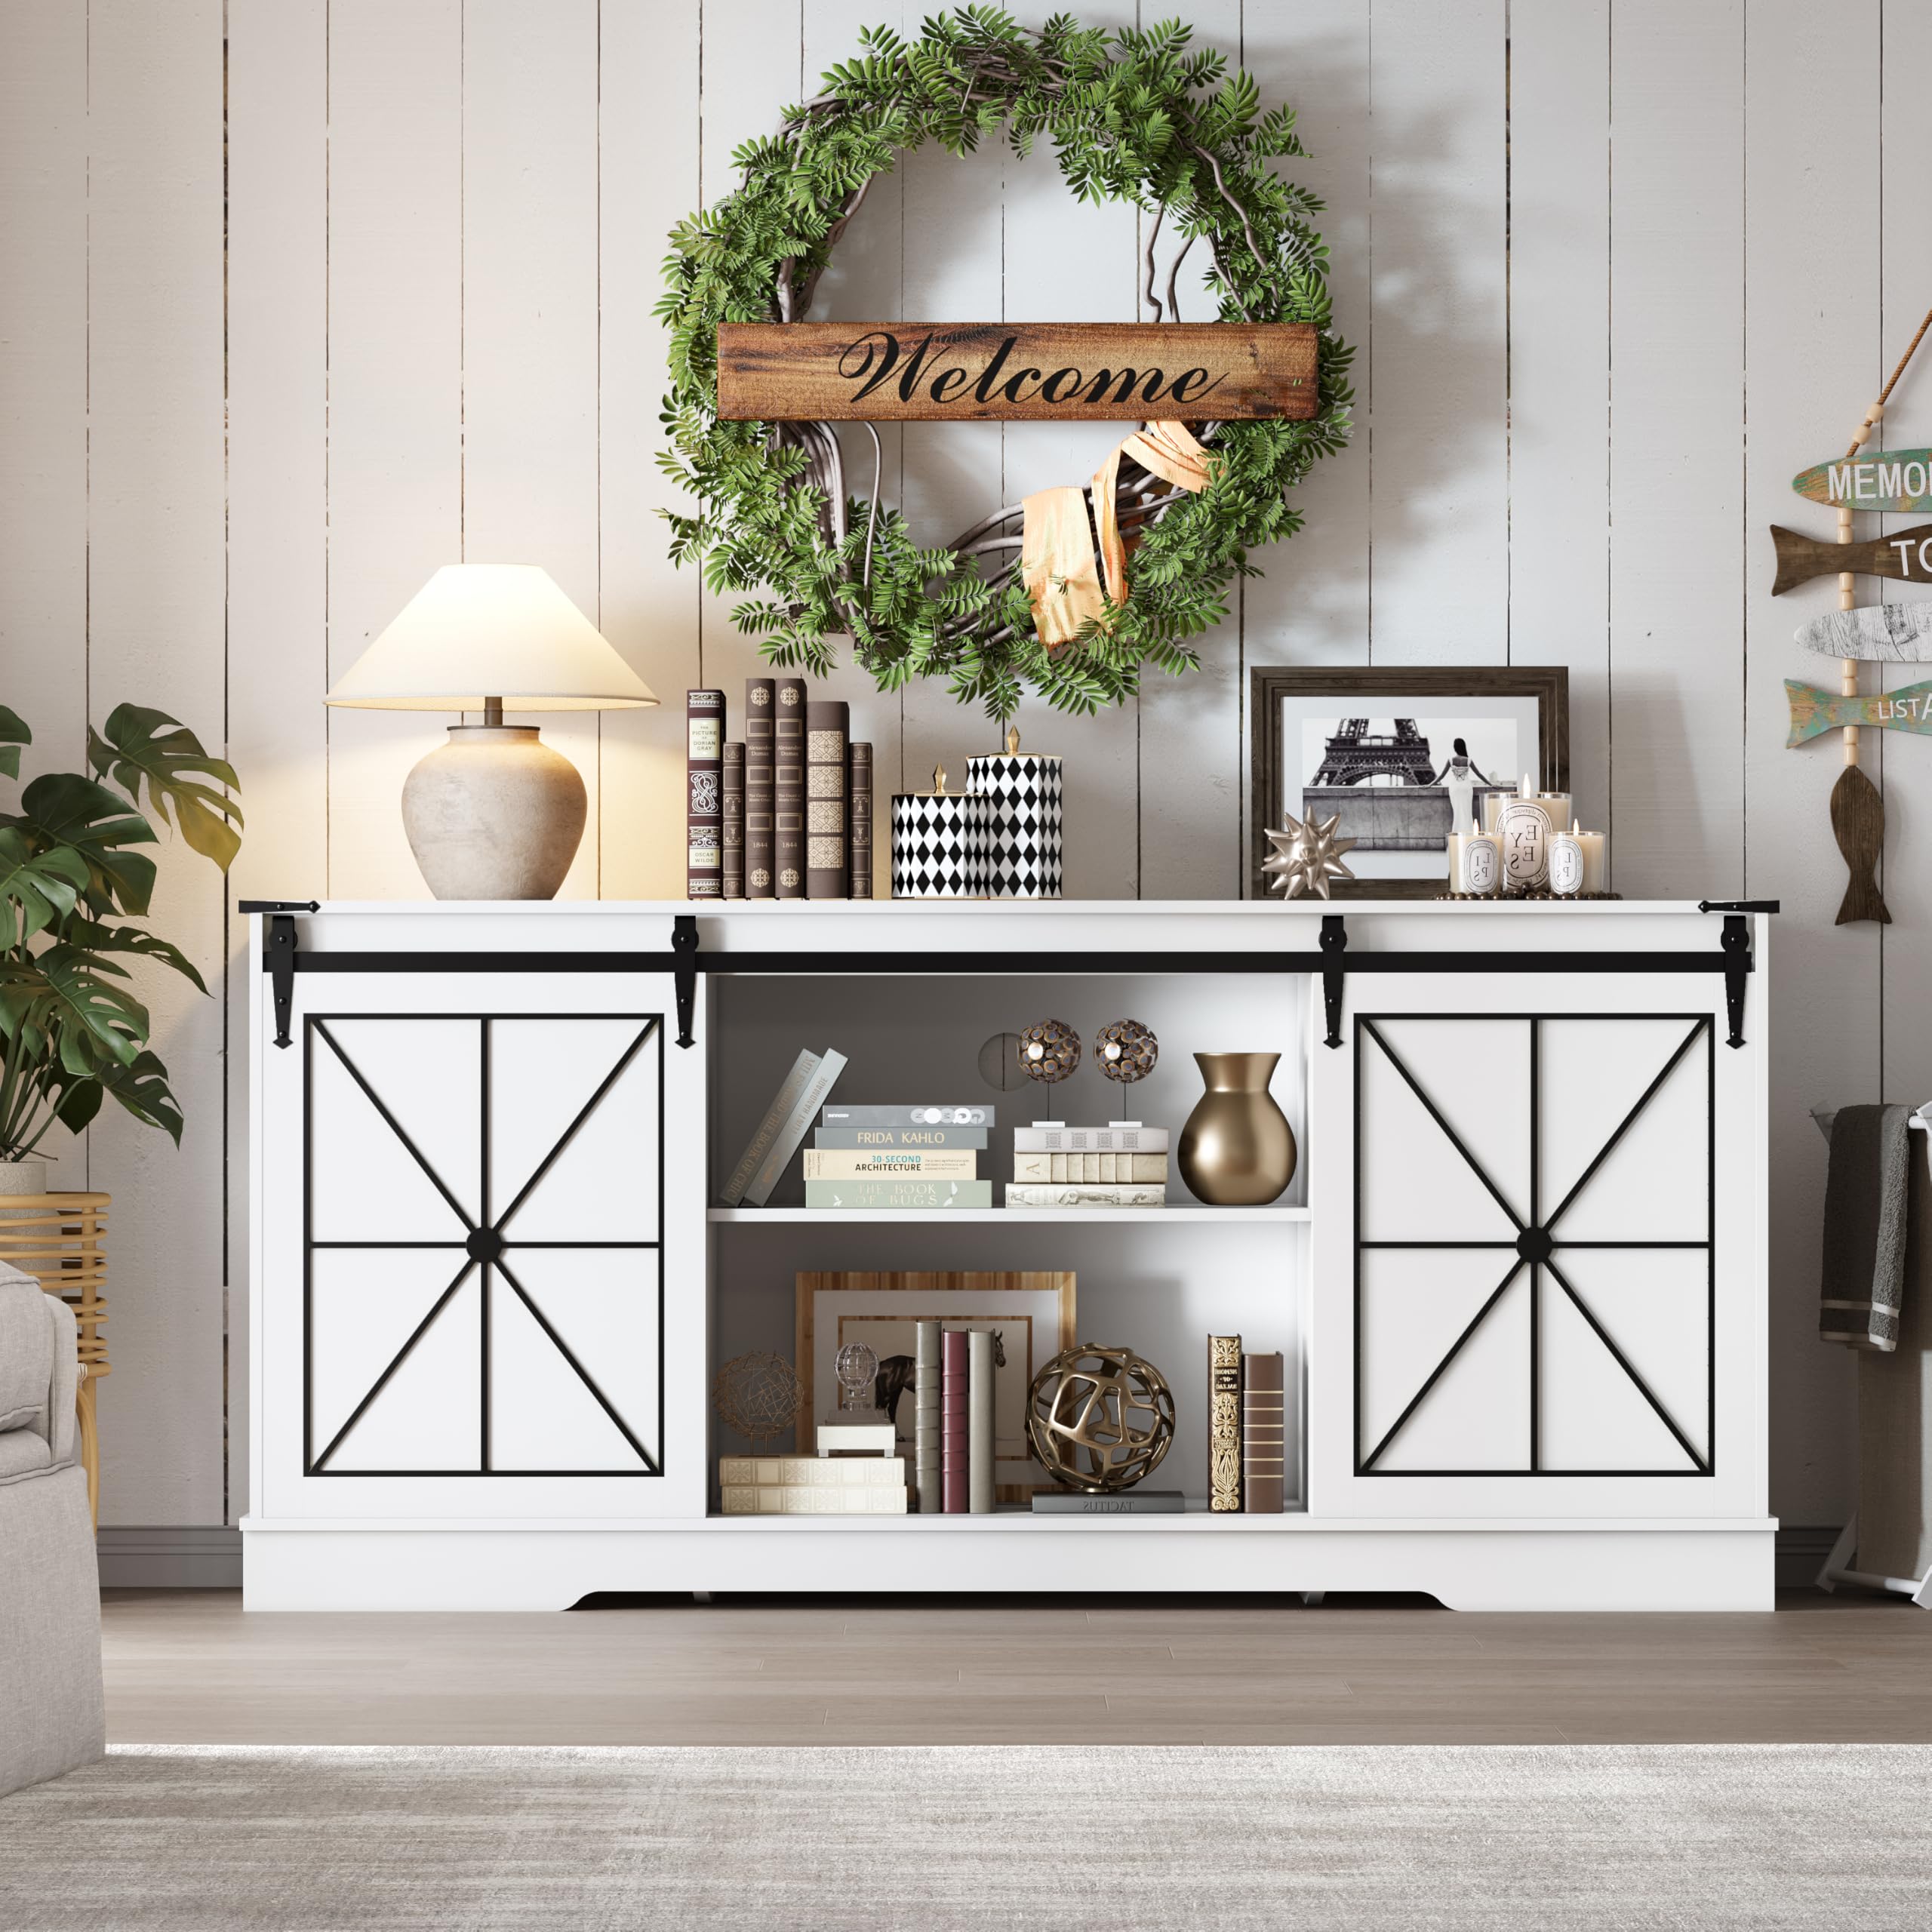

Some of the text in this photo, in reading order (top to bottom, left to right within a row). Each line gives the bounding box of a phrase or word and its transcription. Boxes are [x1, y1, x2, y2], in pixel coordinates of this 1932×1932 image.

[838, 331, 1230, 404] Welcome
[1828, 461, 1932, 500] MEMO
[801, 1075, 828, 1114] HANDMADE
[857, 1132, 945, 1143] FRIDA KAHLO
[890, 1195, 937, 1205] BUGS
[894, 1183, 936, 1194] BOOK
